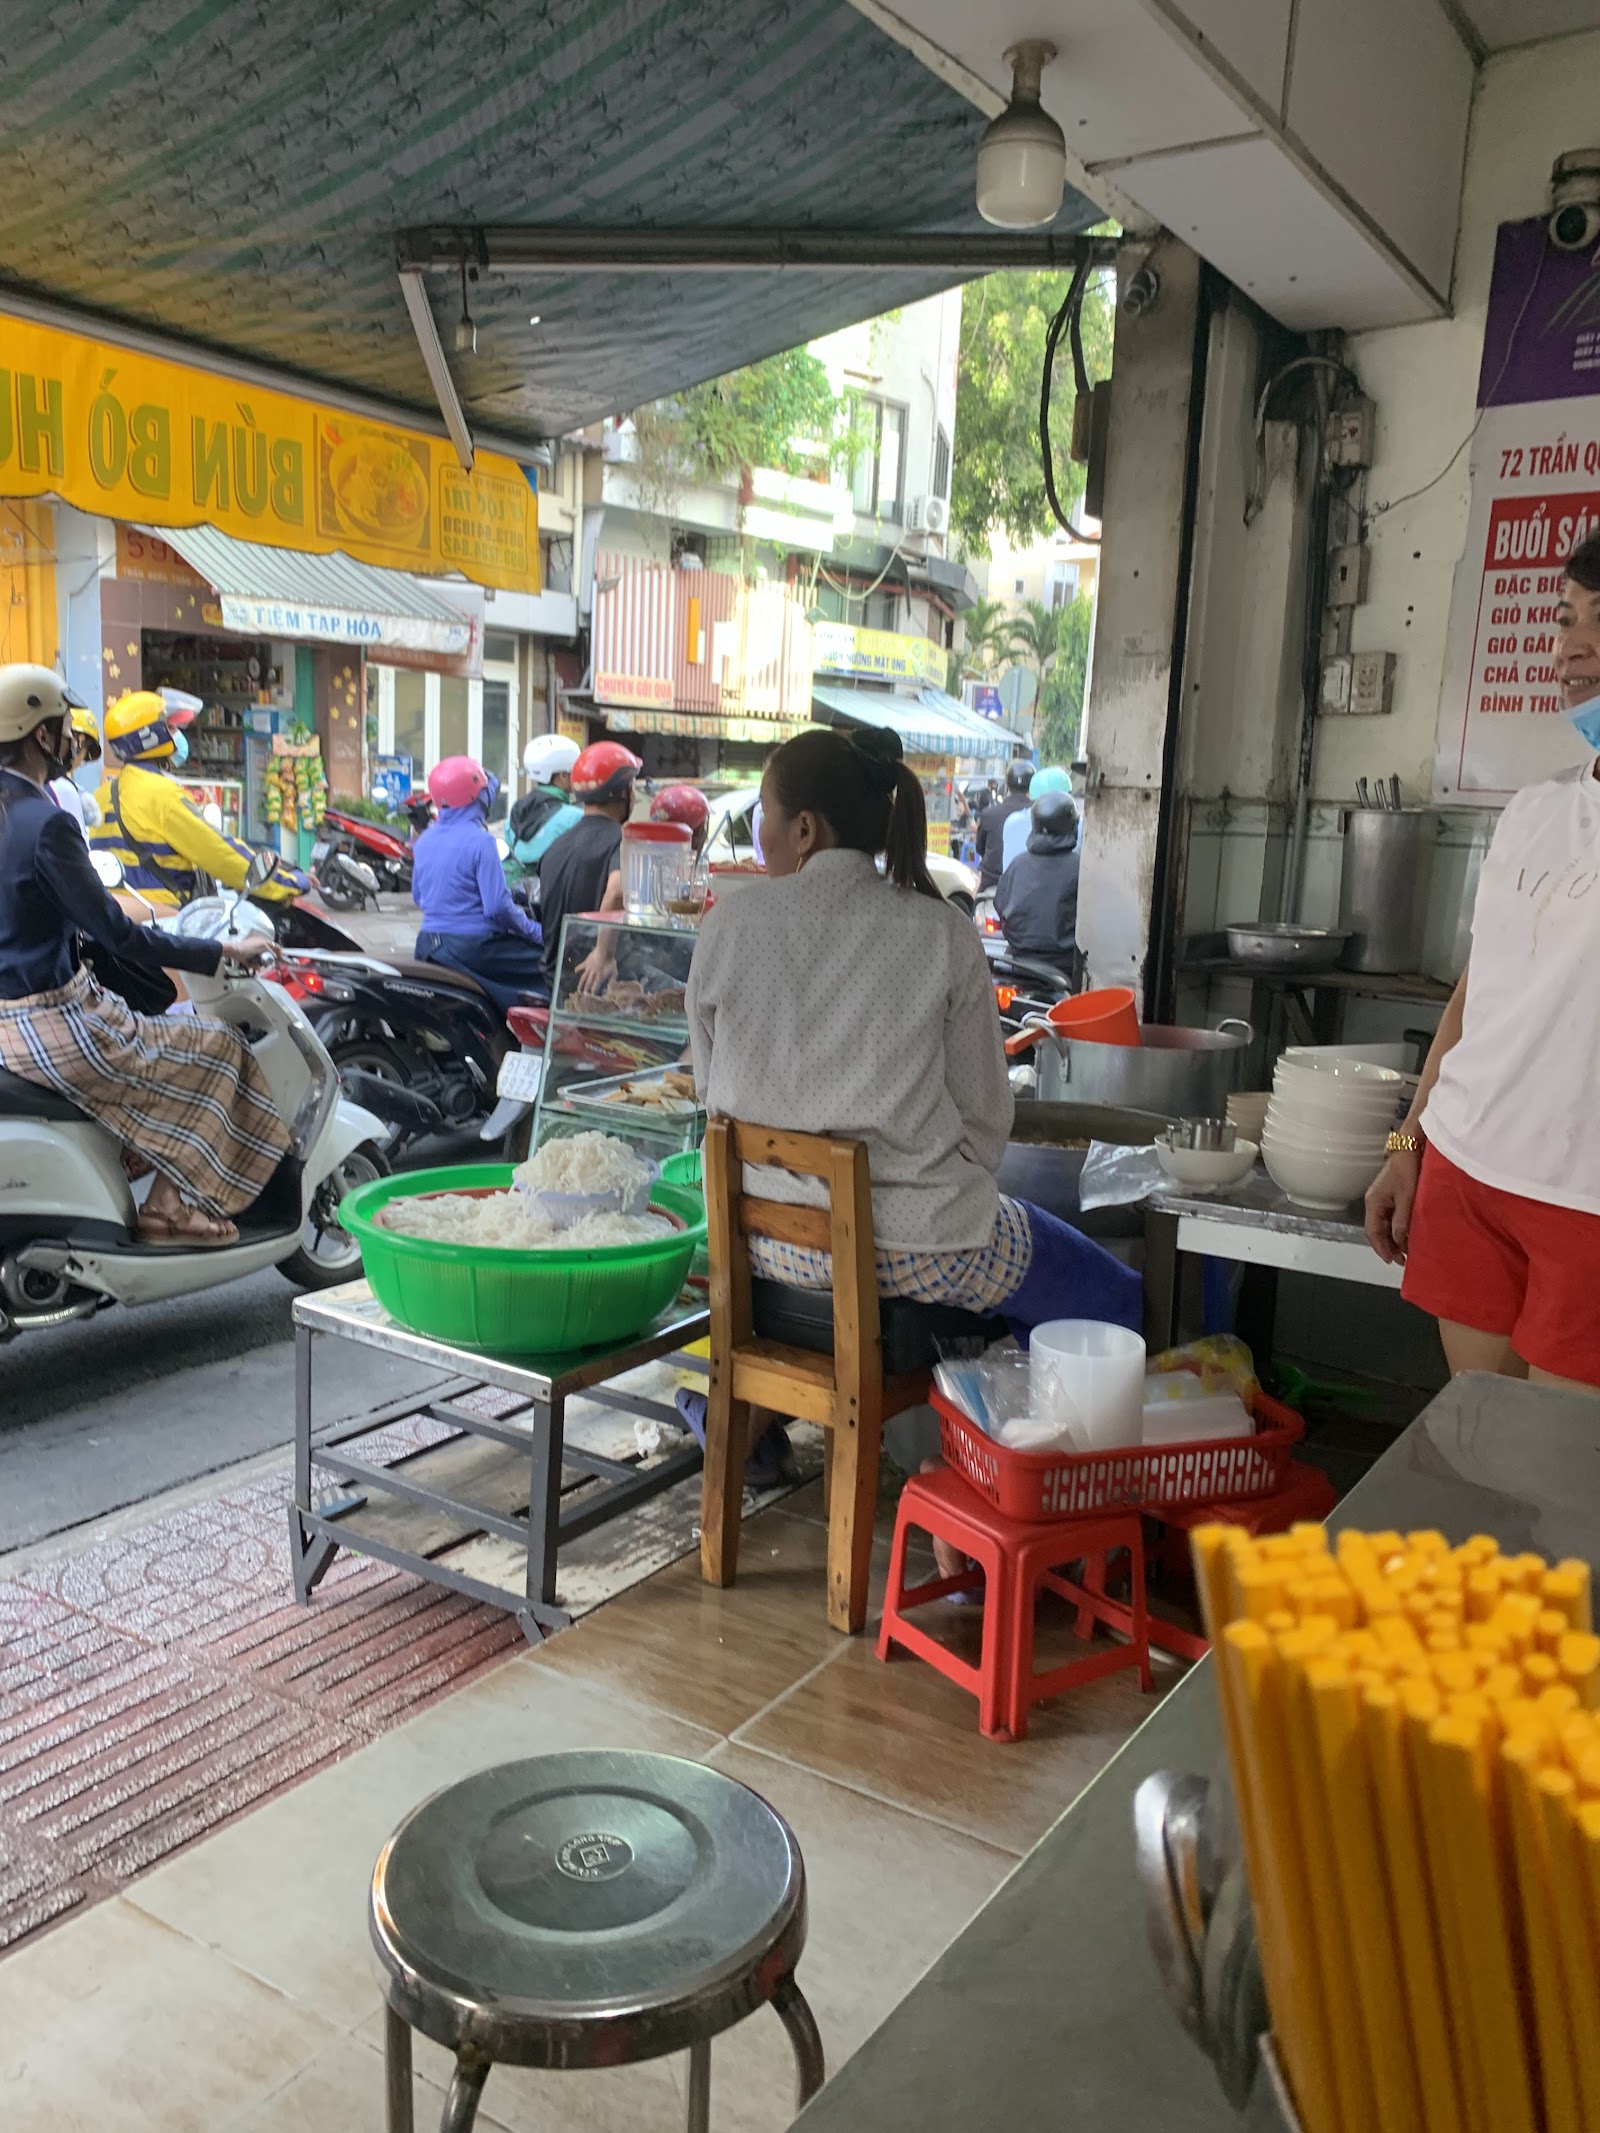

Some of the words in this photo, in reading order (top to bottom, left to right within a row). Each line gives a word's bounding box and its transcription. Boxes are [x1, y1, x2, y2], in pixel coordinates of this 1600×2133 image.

[1500, 448, 1524, 478] 72
[1494, 501, 1552, 560] BUỔI
[1495, 573, 1531, 599] ĐẶC
[255, 606, 300, 630] TIỆM
[307, 613, 340, 634] TẠP
[1484, 660, 1519, 684] CHẢ
[1480, 691, 1523, 713] BÌNH
